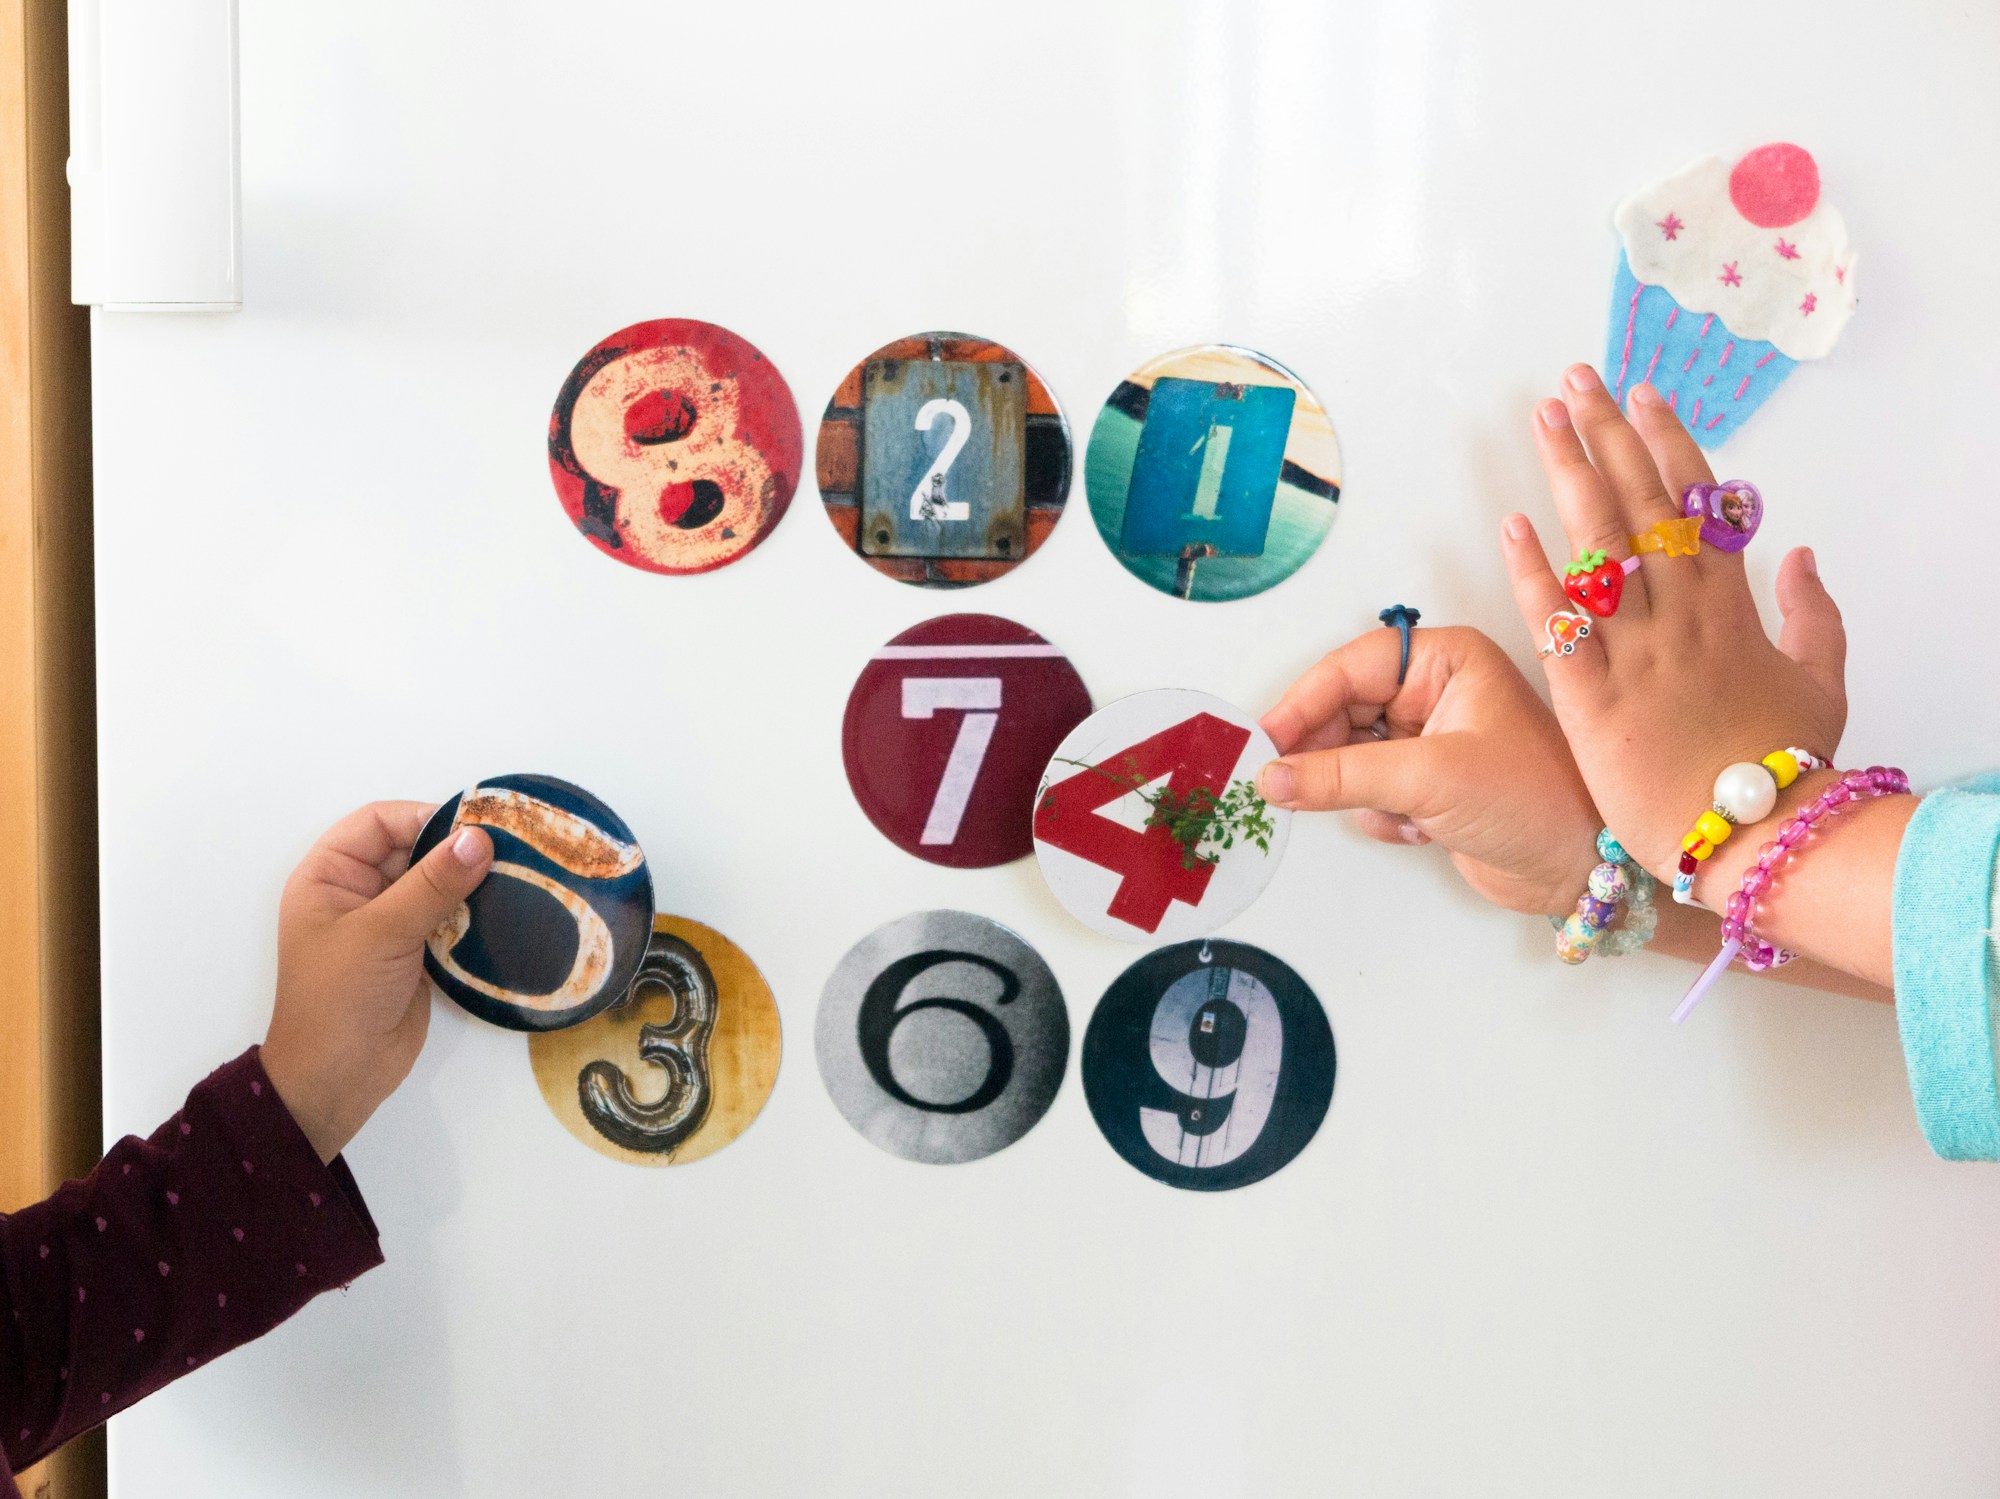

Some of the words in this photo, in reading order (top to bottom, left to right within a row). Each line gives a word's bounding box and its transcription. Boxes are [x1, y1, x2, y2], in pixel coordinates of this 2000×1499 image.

[570, 346, 772, 567] 8
[910, 398, 970, 520] 2
[1182, 424, 1231, 520] 1
[902, 678, 1002, 845] 7
[1033, 712, 1252, 934] 4
[425, 788, 644, 1011] 5
[578, 932, 718, 1155] 3
[857, 950, 1021, 1115] 6
[1139, 967, 1283, 1168] 9
